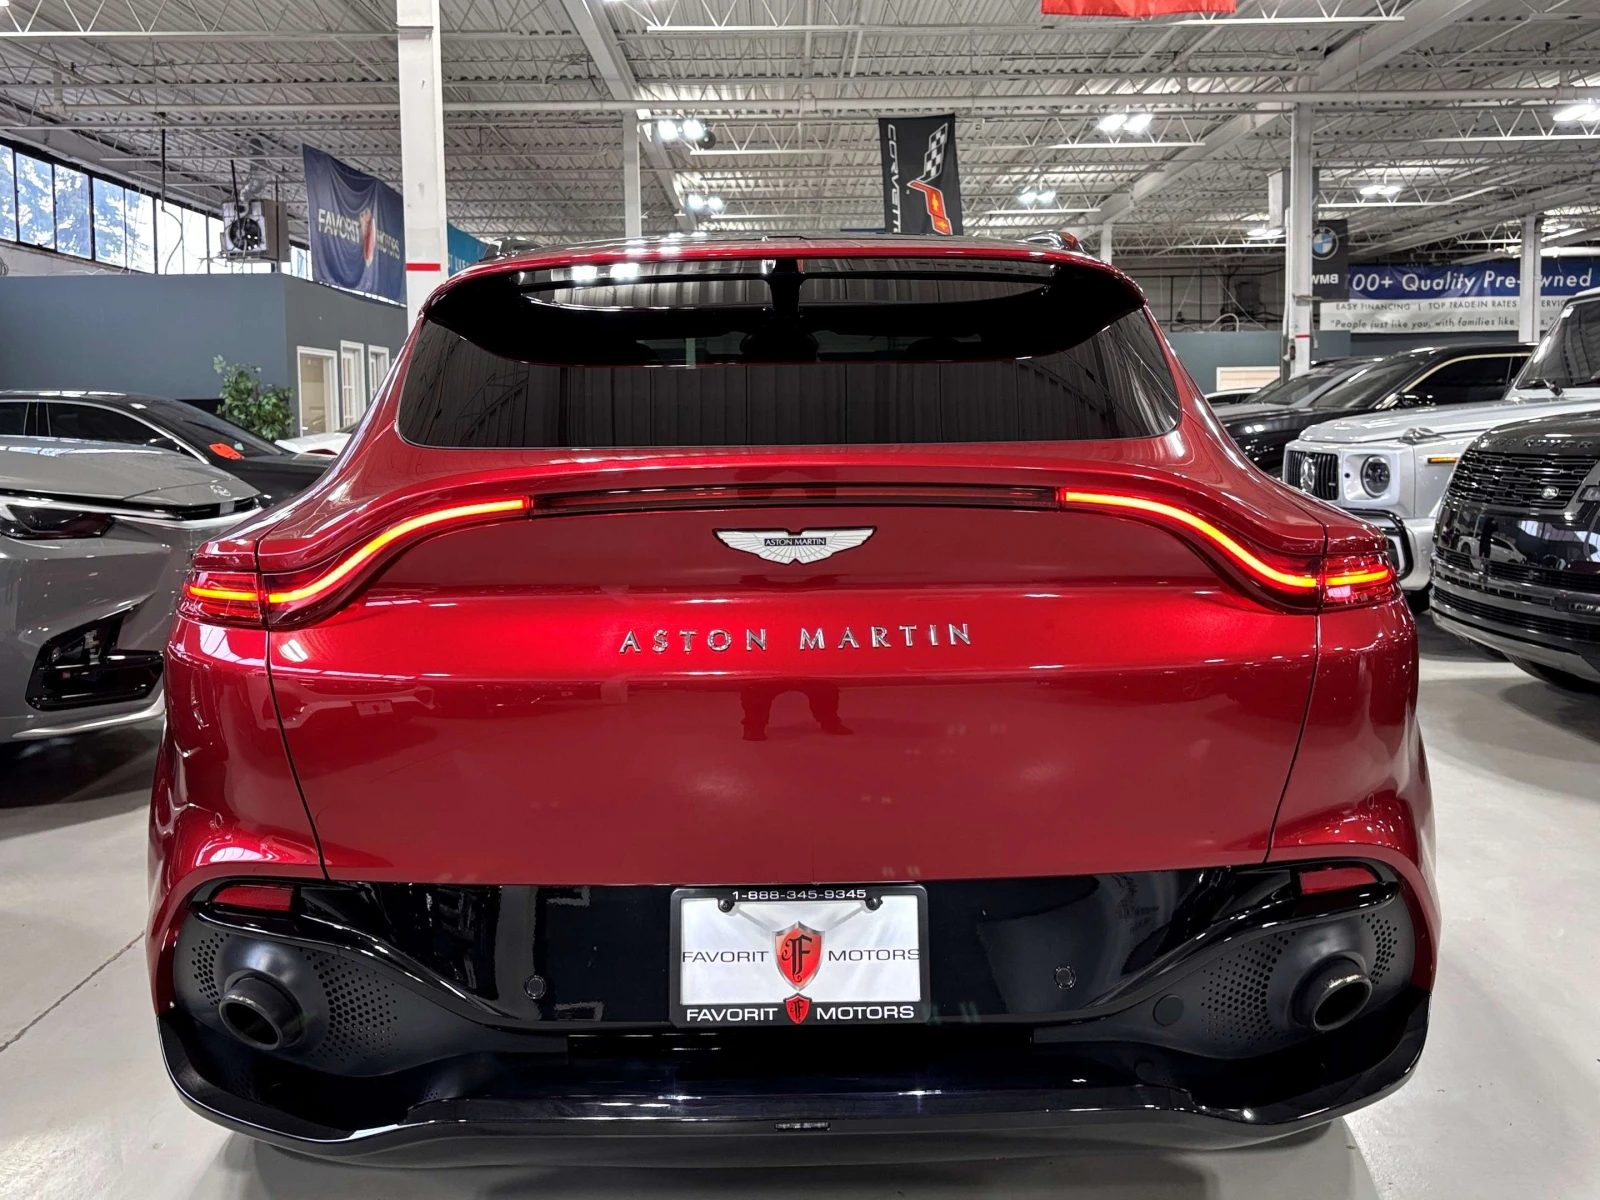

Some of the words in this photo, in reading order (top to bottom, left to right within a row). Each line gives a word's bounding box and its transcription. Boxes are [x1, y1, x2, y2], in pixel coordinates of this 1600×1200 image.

[318, 208, 361, 243] FAVORIT
[1402, 270, 1476, 294] Quality
[1483, 267, 1593, 289] Pre-wned
[1336, 303, 1358, 311] EASY
[1361, 302, 1411, 311] FINANCING
[1428, 301, 1446, 310] TOP
[1449, 300, 1488, 309] TRADE-IN
[1492, 300, 1517, 308] RATES
[1370, 320, 1388, 329] just
[1391, 319, 1408, 328] like
[1411, 320, 1431, 330] you,
[1435, 317, 1455, 327] with
[1457, 317, 1495, 327] families
[1498, 316, 1515, 326] like
[765, 538, 793, 546] ASTON
[794, 537, 825, 546] MARTIN
[619, 629, 768, 655] ASTON
[799, 623, 972, 650] MARTIN
[732, 889, 867, 901] 1-888-345-9345
[682, 950, 769, 963] FAVORIT
[828, 949, 920, 962] MOTORS
[686, 1007, 779, 1022] FAVORIT
[816, 1005, 915, 1020] MOTORS
